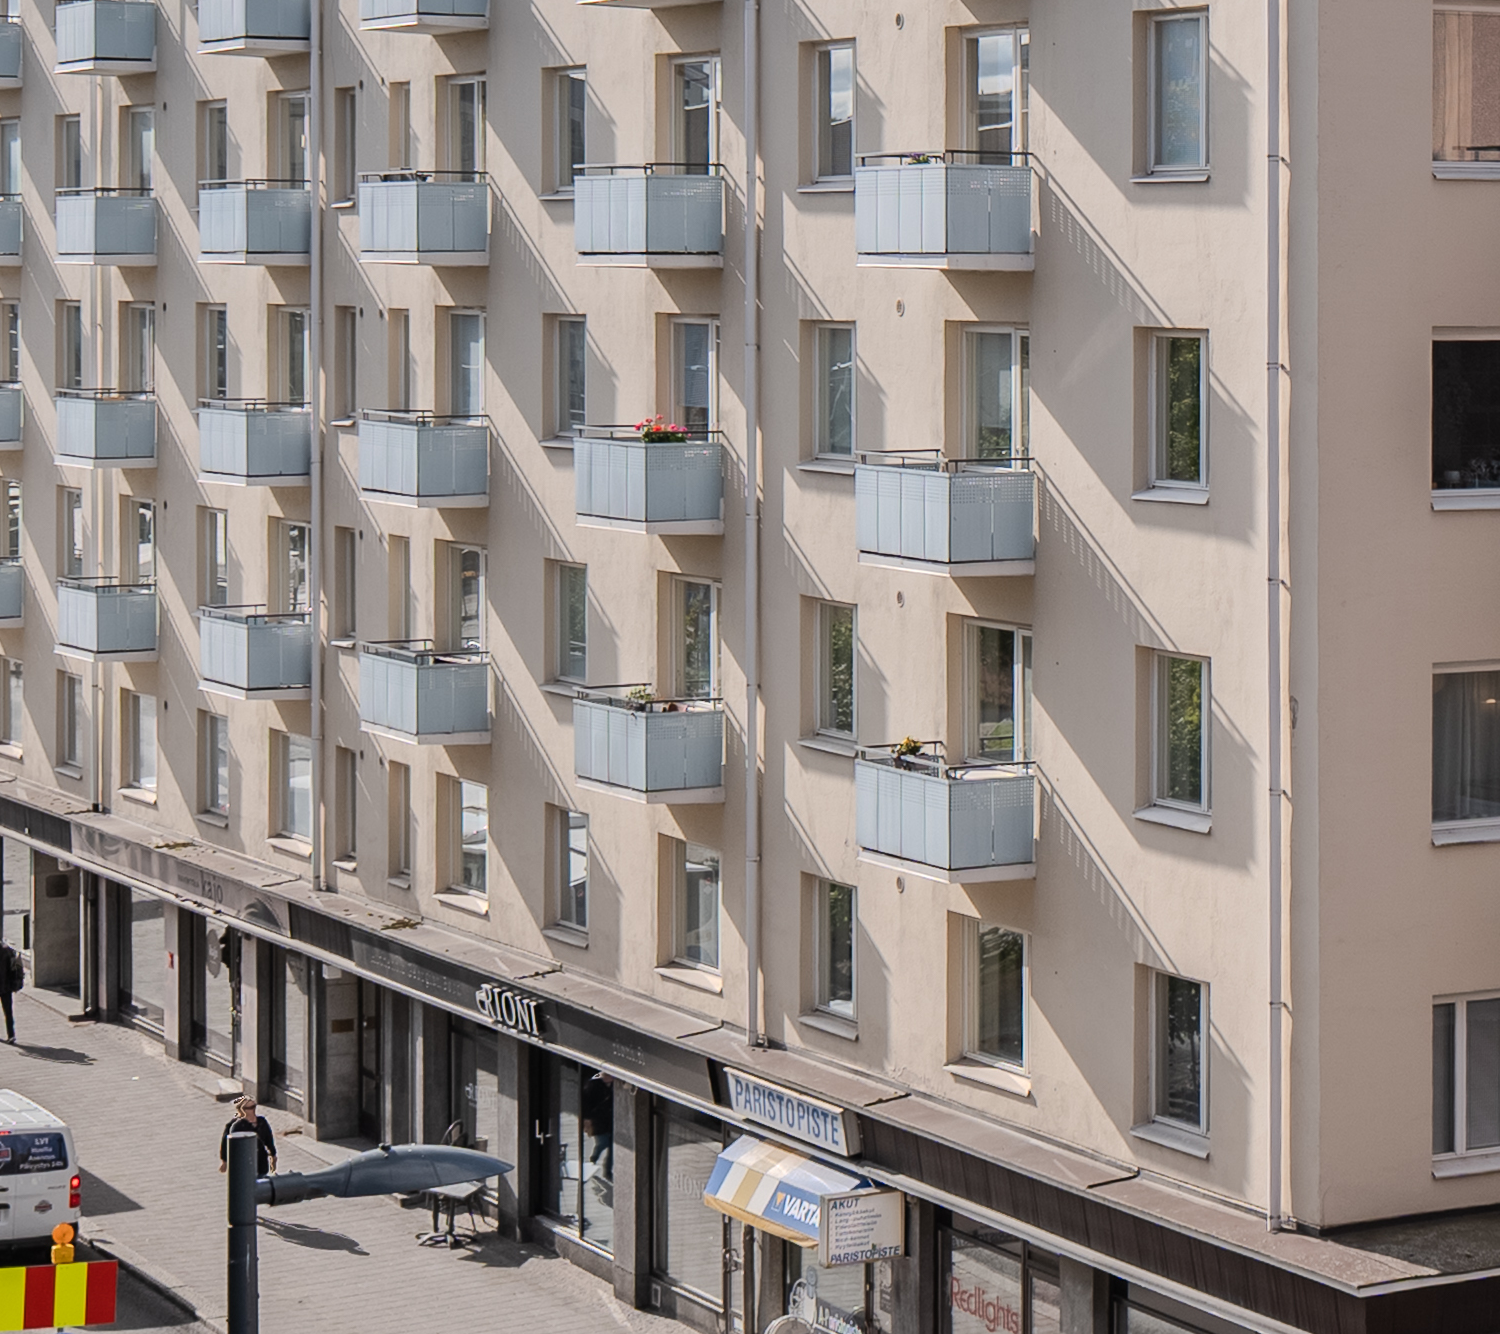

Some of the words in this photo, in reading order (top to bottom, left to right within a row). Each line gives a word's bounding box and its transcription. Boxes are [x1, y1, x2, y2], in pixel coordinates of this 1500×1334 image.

[735, 1078, 840, 1146] PARISTOPISTE
[782, 1194, 821, 1228] VARTA
[830, 1198, 860, 1211] AKUT
[831, 1245, 900, 1262] PARISTOPISTE
[951, 1277, 1020, 1334] Redlights
